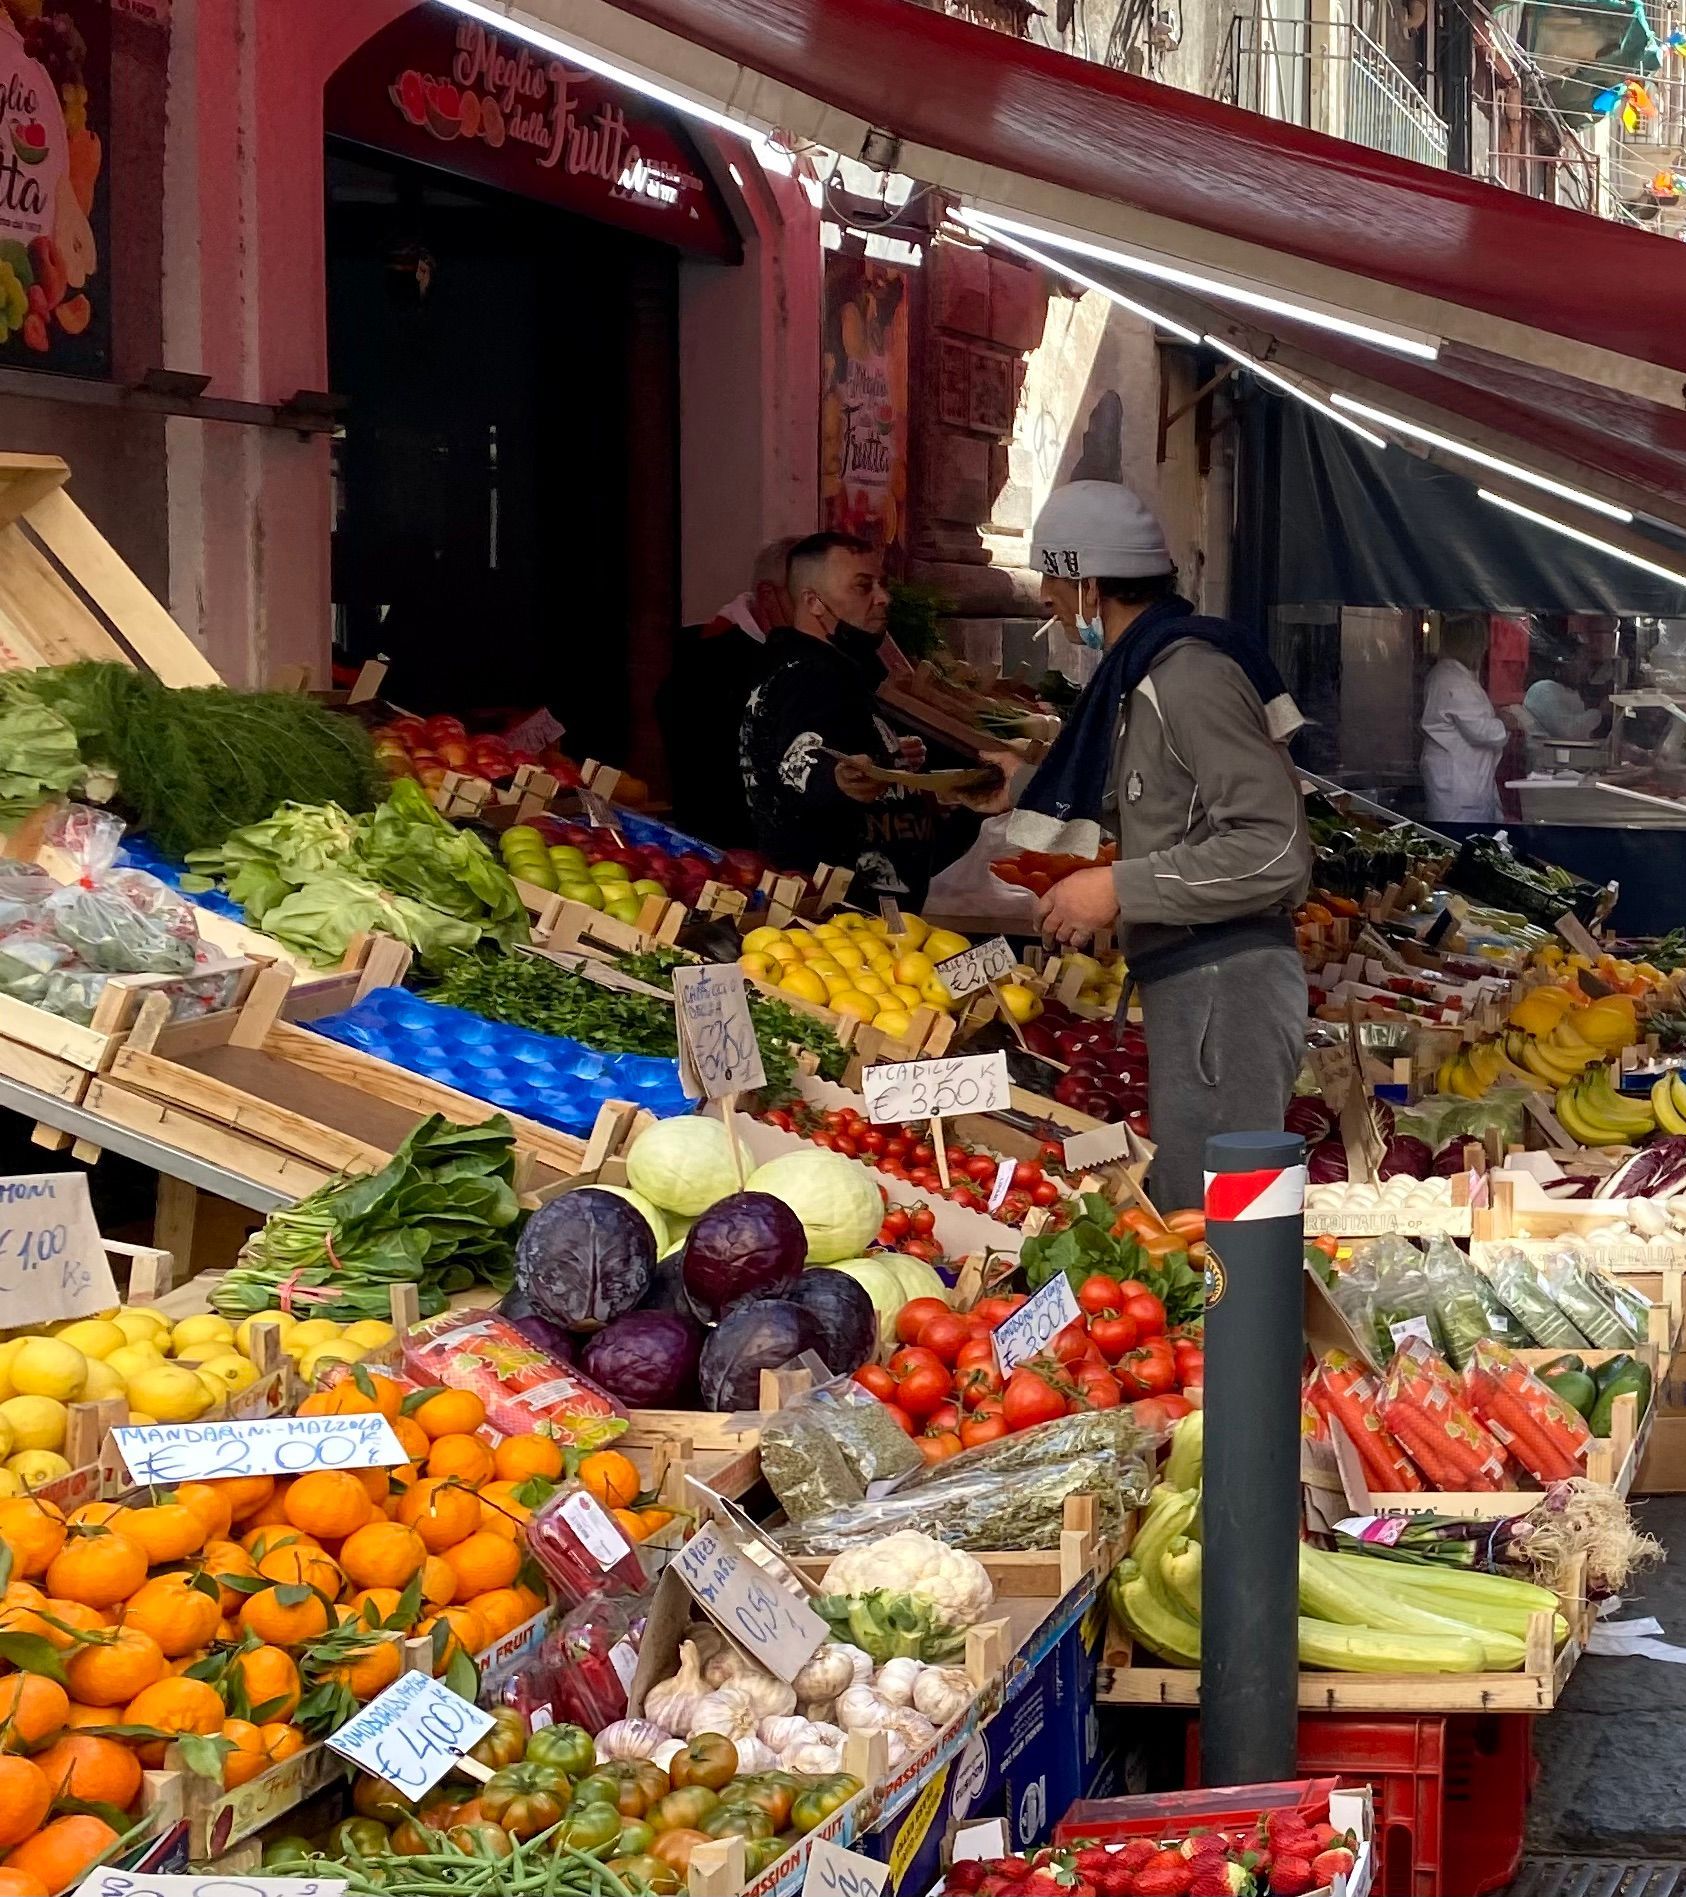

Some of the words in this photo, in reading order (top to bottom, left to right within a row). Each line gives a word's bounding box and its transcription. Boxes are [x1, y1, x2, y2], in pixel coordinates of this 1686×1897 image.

[454, 30, 547, 113] Meglio
[510, 105, 550, 148] della
[536, 60, 647, 193] Frutta
[1304, 1213, 1400, 1231] RTOITALIA
[496, 1624, 536, 1664] FRUIT
[884, 1743, 938, 1798] PASSION
[741, 1848, 802, 1897] ASSION
